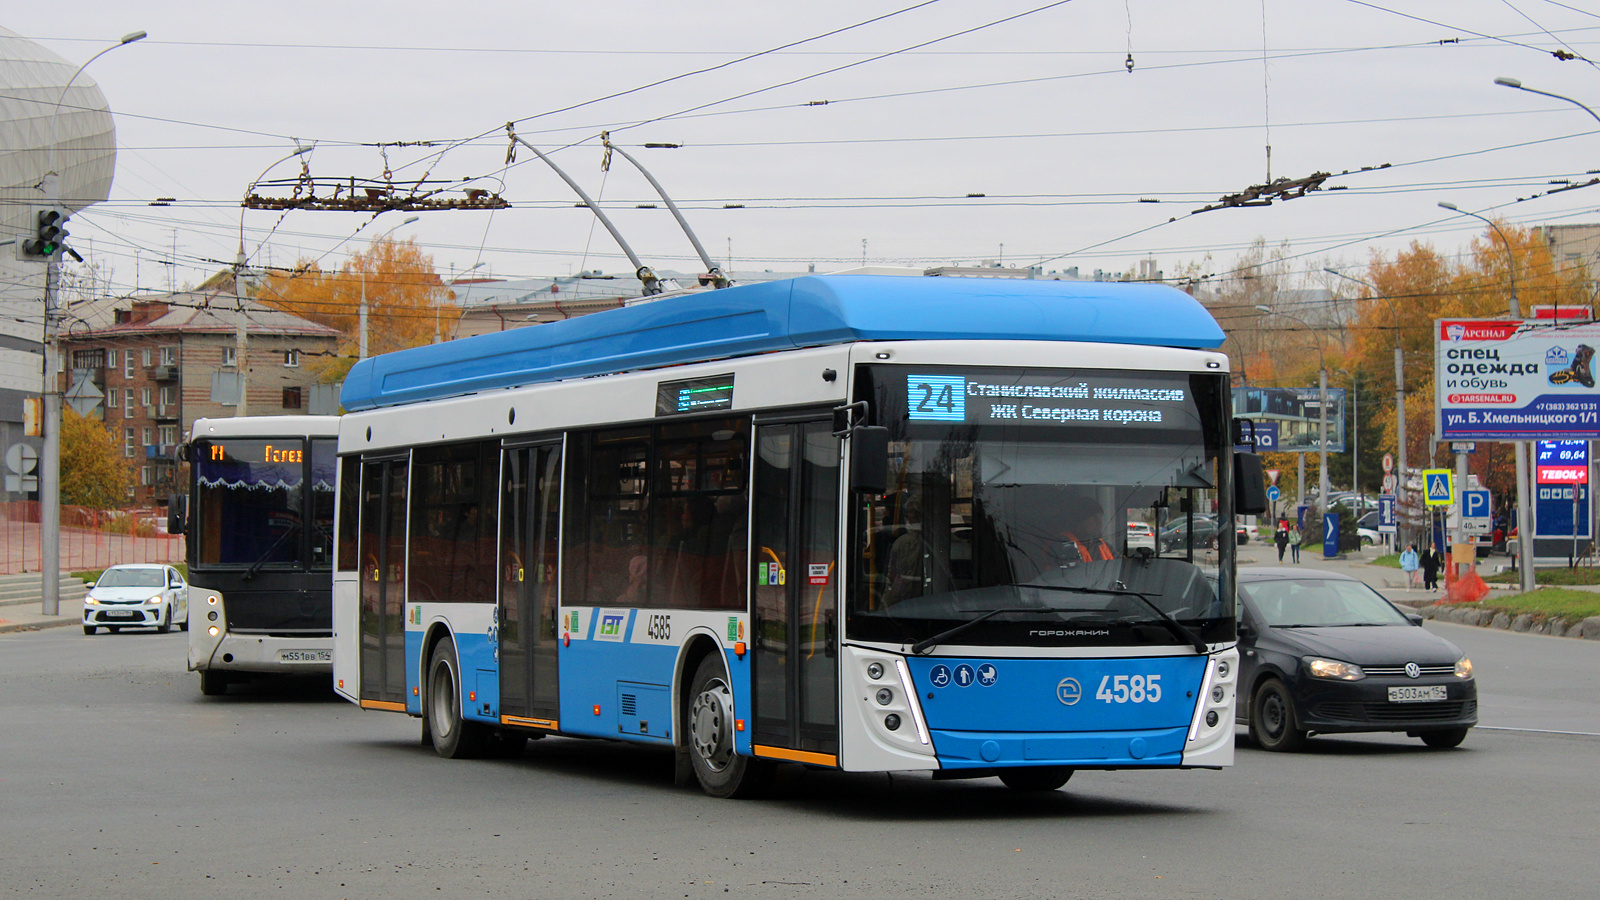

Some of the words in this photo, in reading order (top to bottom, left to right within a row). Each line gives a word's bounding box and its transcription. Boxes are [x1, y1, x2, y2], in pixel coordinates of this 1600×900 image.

[1464, 329, 1506, 338] АРСЕНАЛ
[1446, 349, 1500, 361] спец
[1446, 363, 1539, 376] одежда
[1447, 379, 1456, 388] и
[1460, 377, 1508, 390] обувь
[967, 382, 1089, 399] Станиславский
[1093, 387, 1185, 401] жилмассив
[917, 384, 955, 413] 24
[1545, 403, 1565, 411] (383)
[990, 404, 1018, 419] ЖК
[1021, 405, 1099, 423] Северная
[1103, 408, 1162, 424] корона
[1448, 414, 1466, 426] ул.
[1468, 412, 1480, 423] Б.
[1483, 412, 1577, 425] Хмельницкого
[1579, 412, 1597, 423] 1/1
[1540, 451, 1552, 460] ДТ
[1559, 451, 1585, 461] 69,64
[647, 614, 671, 641] 4585
[1095, 674, 1162, 704] 4585
